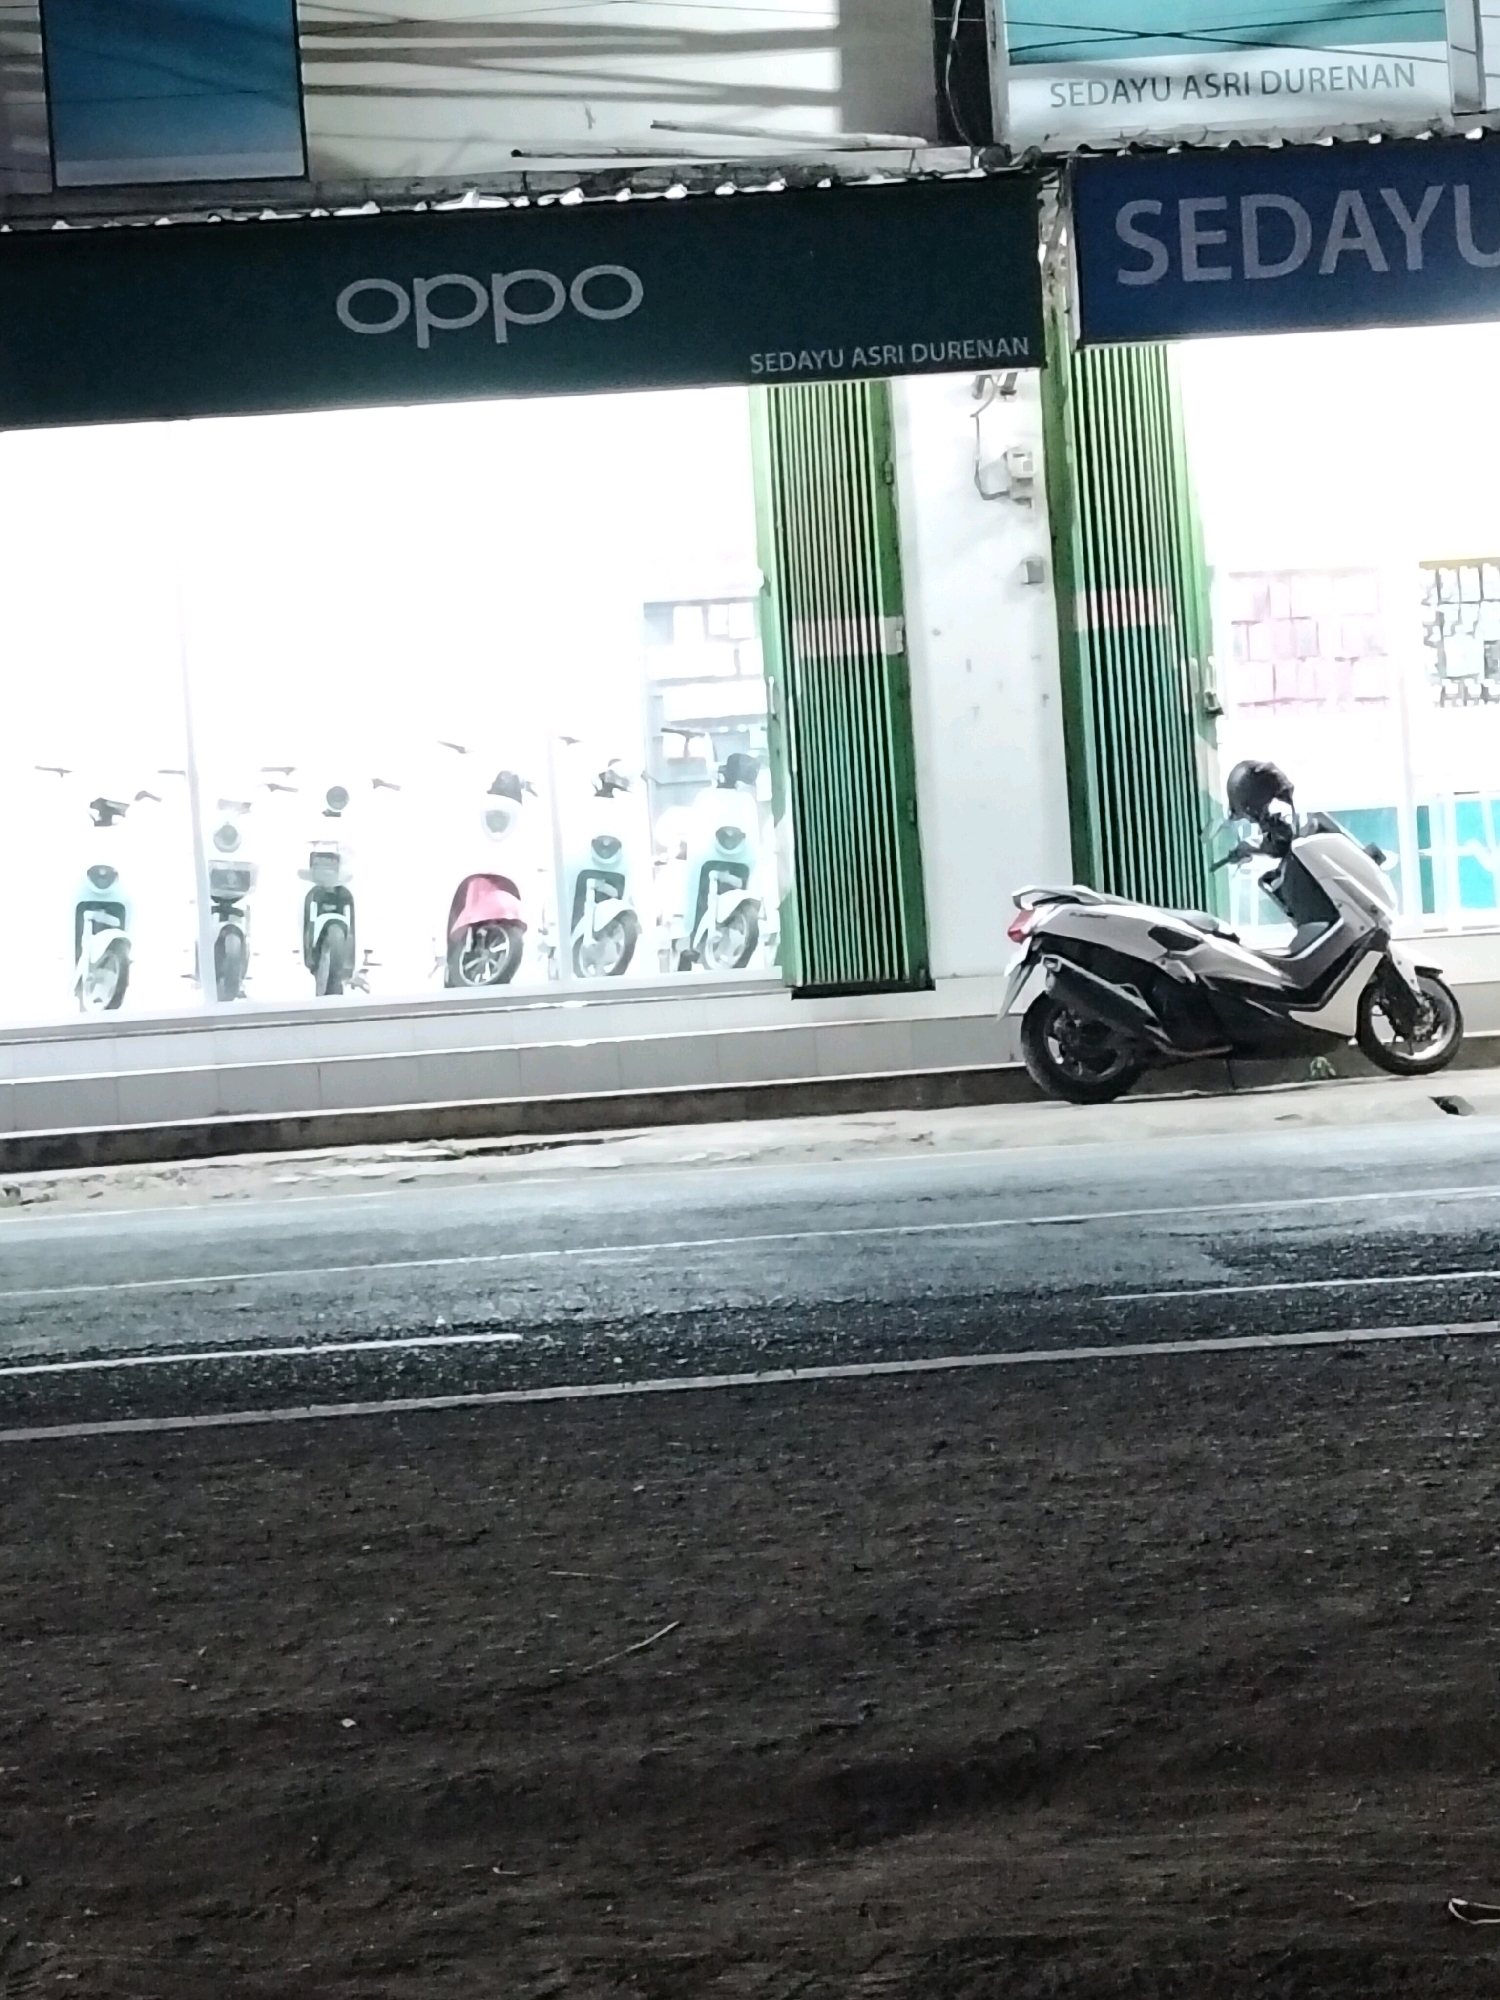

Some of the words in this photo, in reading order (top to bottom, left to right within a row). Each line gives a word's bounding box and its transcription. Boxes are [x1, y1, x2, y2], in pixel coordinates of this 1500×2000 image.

[1050, 76, 1171, 108] SEDAYU
[1182, 71, 1250, 100] ASRI
[1261, 62, 1416, 96] DURENAN
[1115, 183, 1500, 285] SEDAYU
[750, 348, 844, 374] SEDAYU
[852, 344, 903, 368] ASRI
[911, 336, 1029, 363] DURENAN
